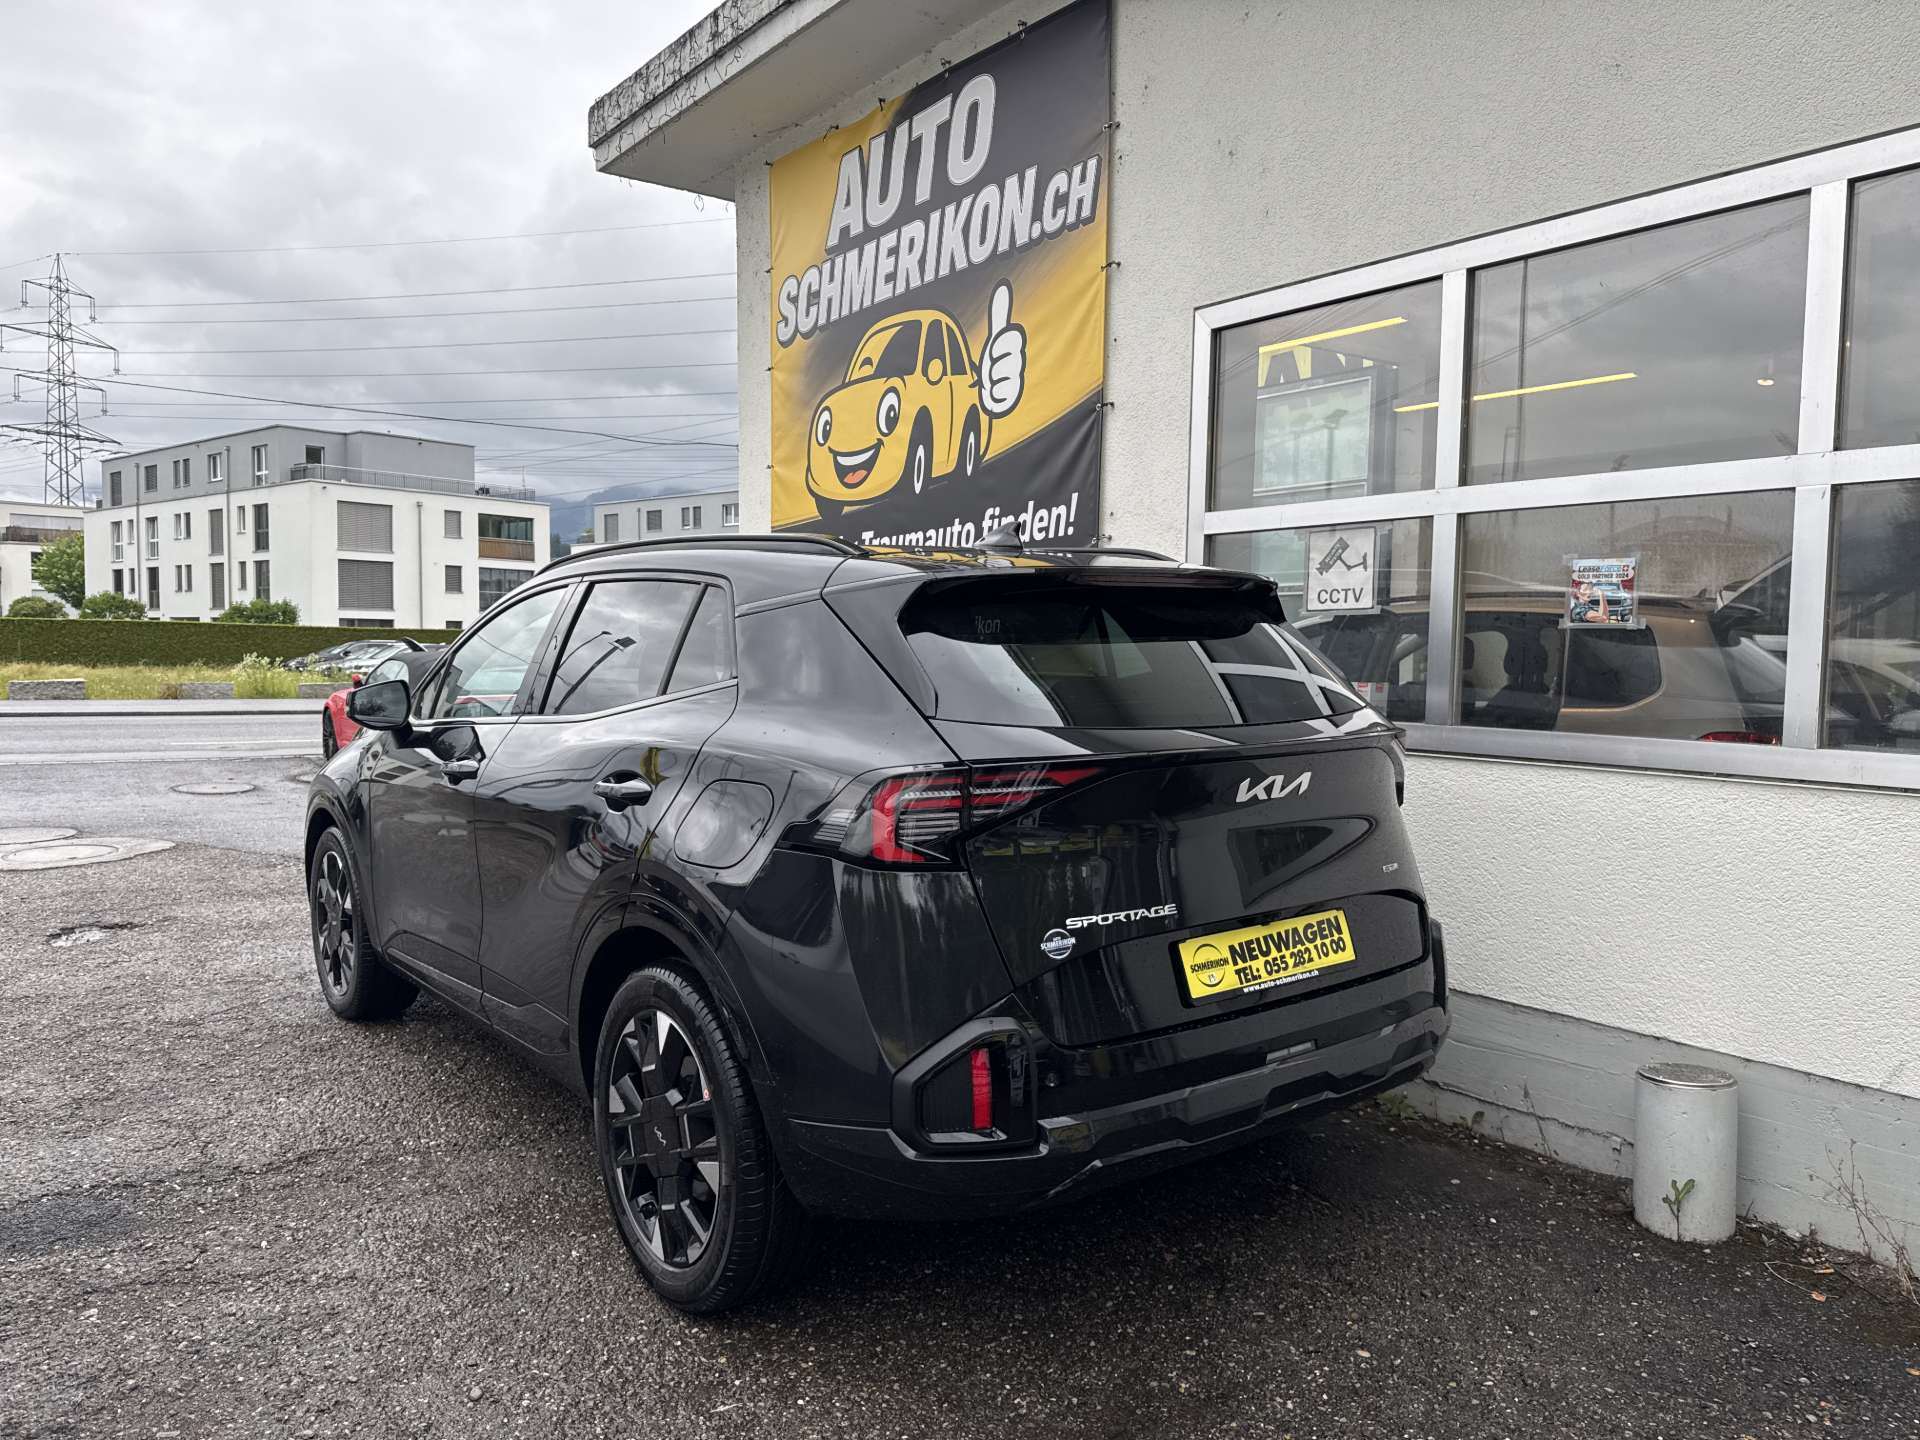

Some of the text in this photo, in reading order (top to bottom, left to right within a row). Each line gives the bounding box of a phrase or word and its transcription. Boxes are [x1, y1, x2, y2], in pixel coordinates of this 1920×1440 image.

[825, 73, 996, 252] AUTO
[777, 155, 1100, 343] SCHMERIKON.CH
[1317, 587, 1364, 605] CCTV
[1065, 903, 1178, 929] SPORTAGE
[1228, 915, 1343, 966] NEUWAGEN
[1190, 957, 1229, 973] SCHMERIKON
[1234, 964, 1262, 985] TEL:
[1263, 954, 1289, 976] 055
[1289, 946, 1314, 969] 282
[1313, 941, 1330, 960] 10
[1329, 936, 1347, 955] 00
[1242, 969, 1320, 993] www.auto-schmerikon.ch
